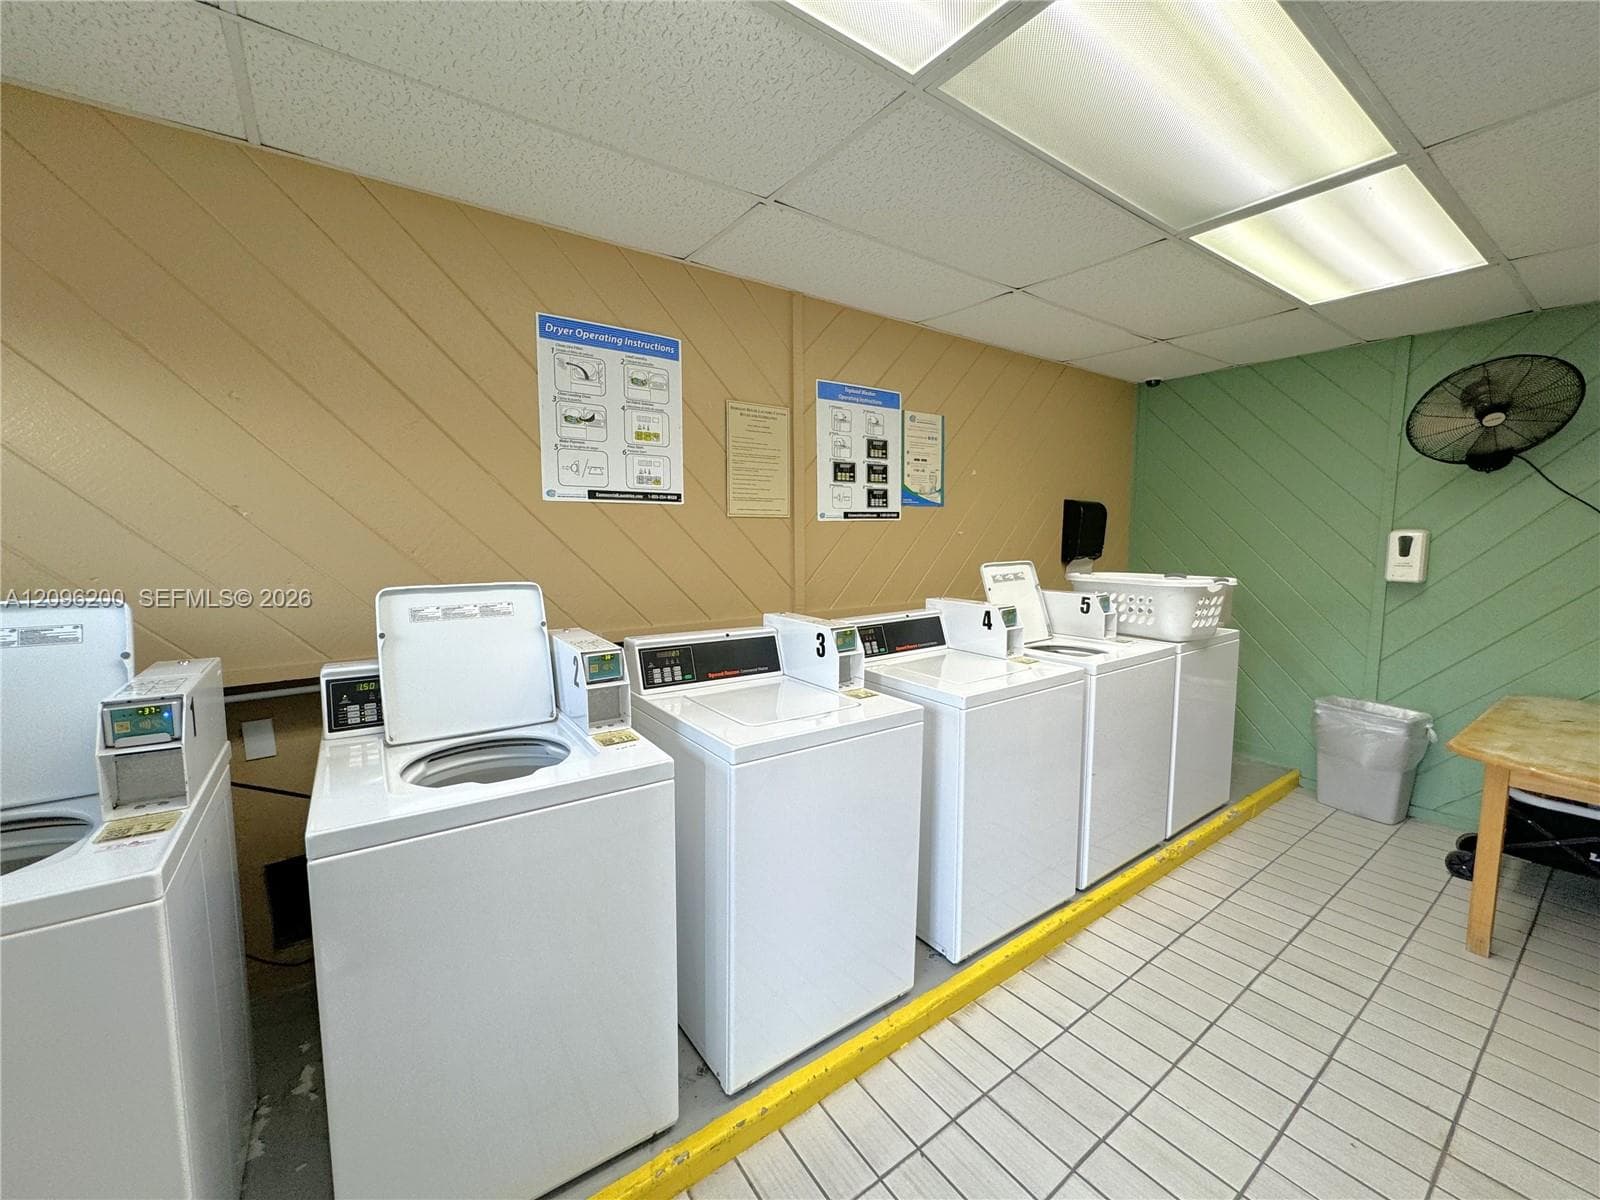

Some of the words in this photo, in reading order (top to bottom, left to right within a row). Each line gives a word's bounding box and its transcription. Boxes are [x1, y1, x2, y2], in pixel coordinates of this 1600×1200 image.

[544, 322, 574, 338] Dryer
[575, 328, 623, 347] Operating
[624, 337, 676, 354] Instructions
[552, 395, 557, 403] 3
[554, 443, 559, 451] 5
[1079, 596, 1091, 614] 5
[982, 610, 993, 630] 4
[816, 632, 826, 658] 3
[573, 655, 580, 688] 2
[190, 696, 197, 737] 1
